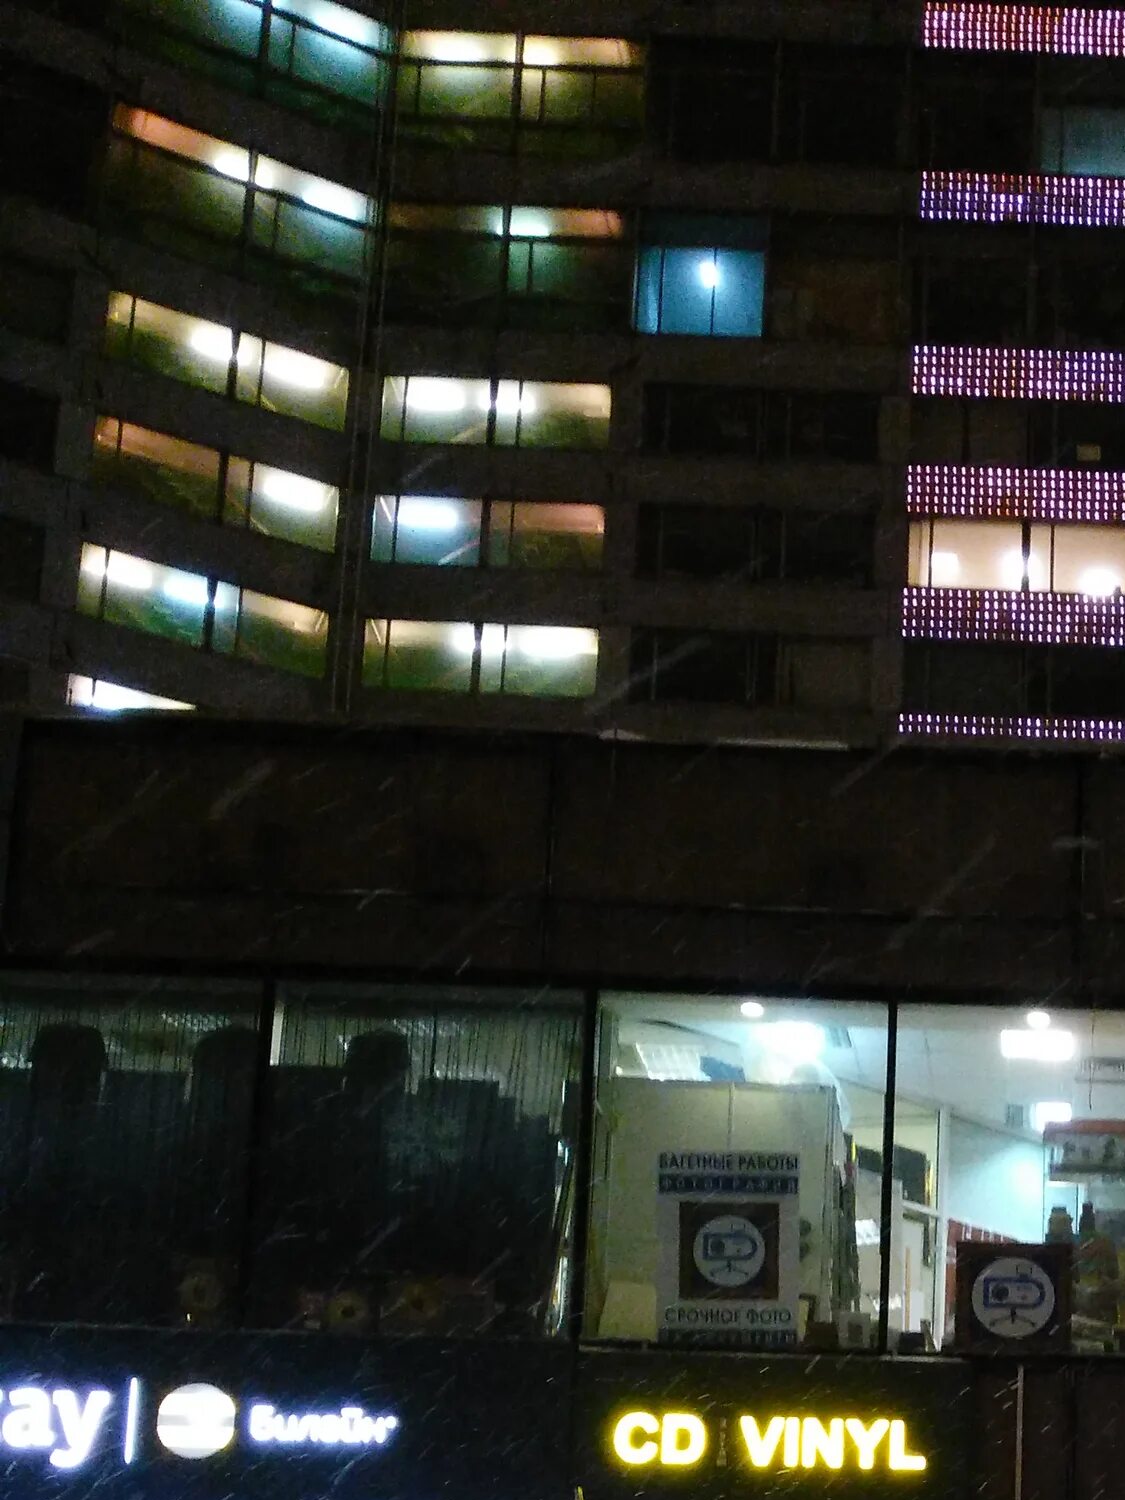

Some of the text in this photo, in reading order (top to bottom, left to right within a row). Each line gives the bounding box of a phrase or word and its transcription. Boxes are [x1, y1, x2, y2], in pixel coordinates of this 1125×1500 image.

[738, 1152, 799, 1170] РАБОТЫ
[746, 1307, 792, 1325] ФОТО
[0, 1386, 112, 1468] ay
[612, 1411, 928, 1471] CD VINYL
